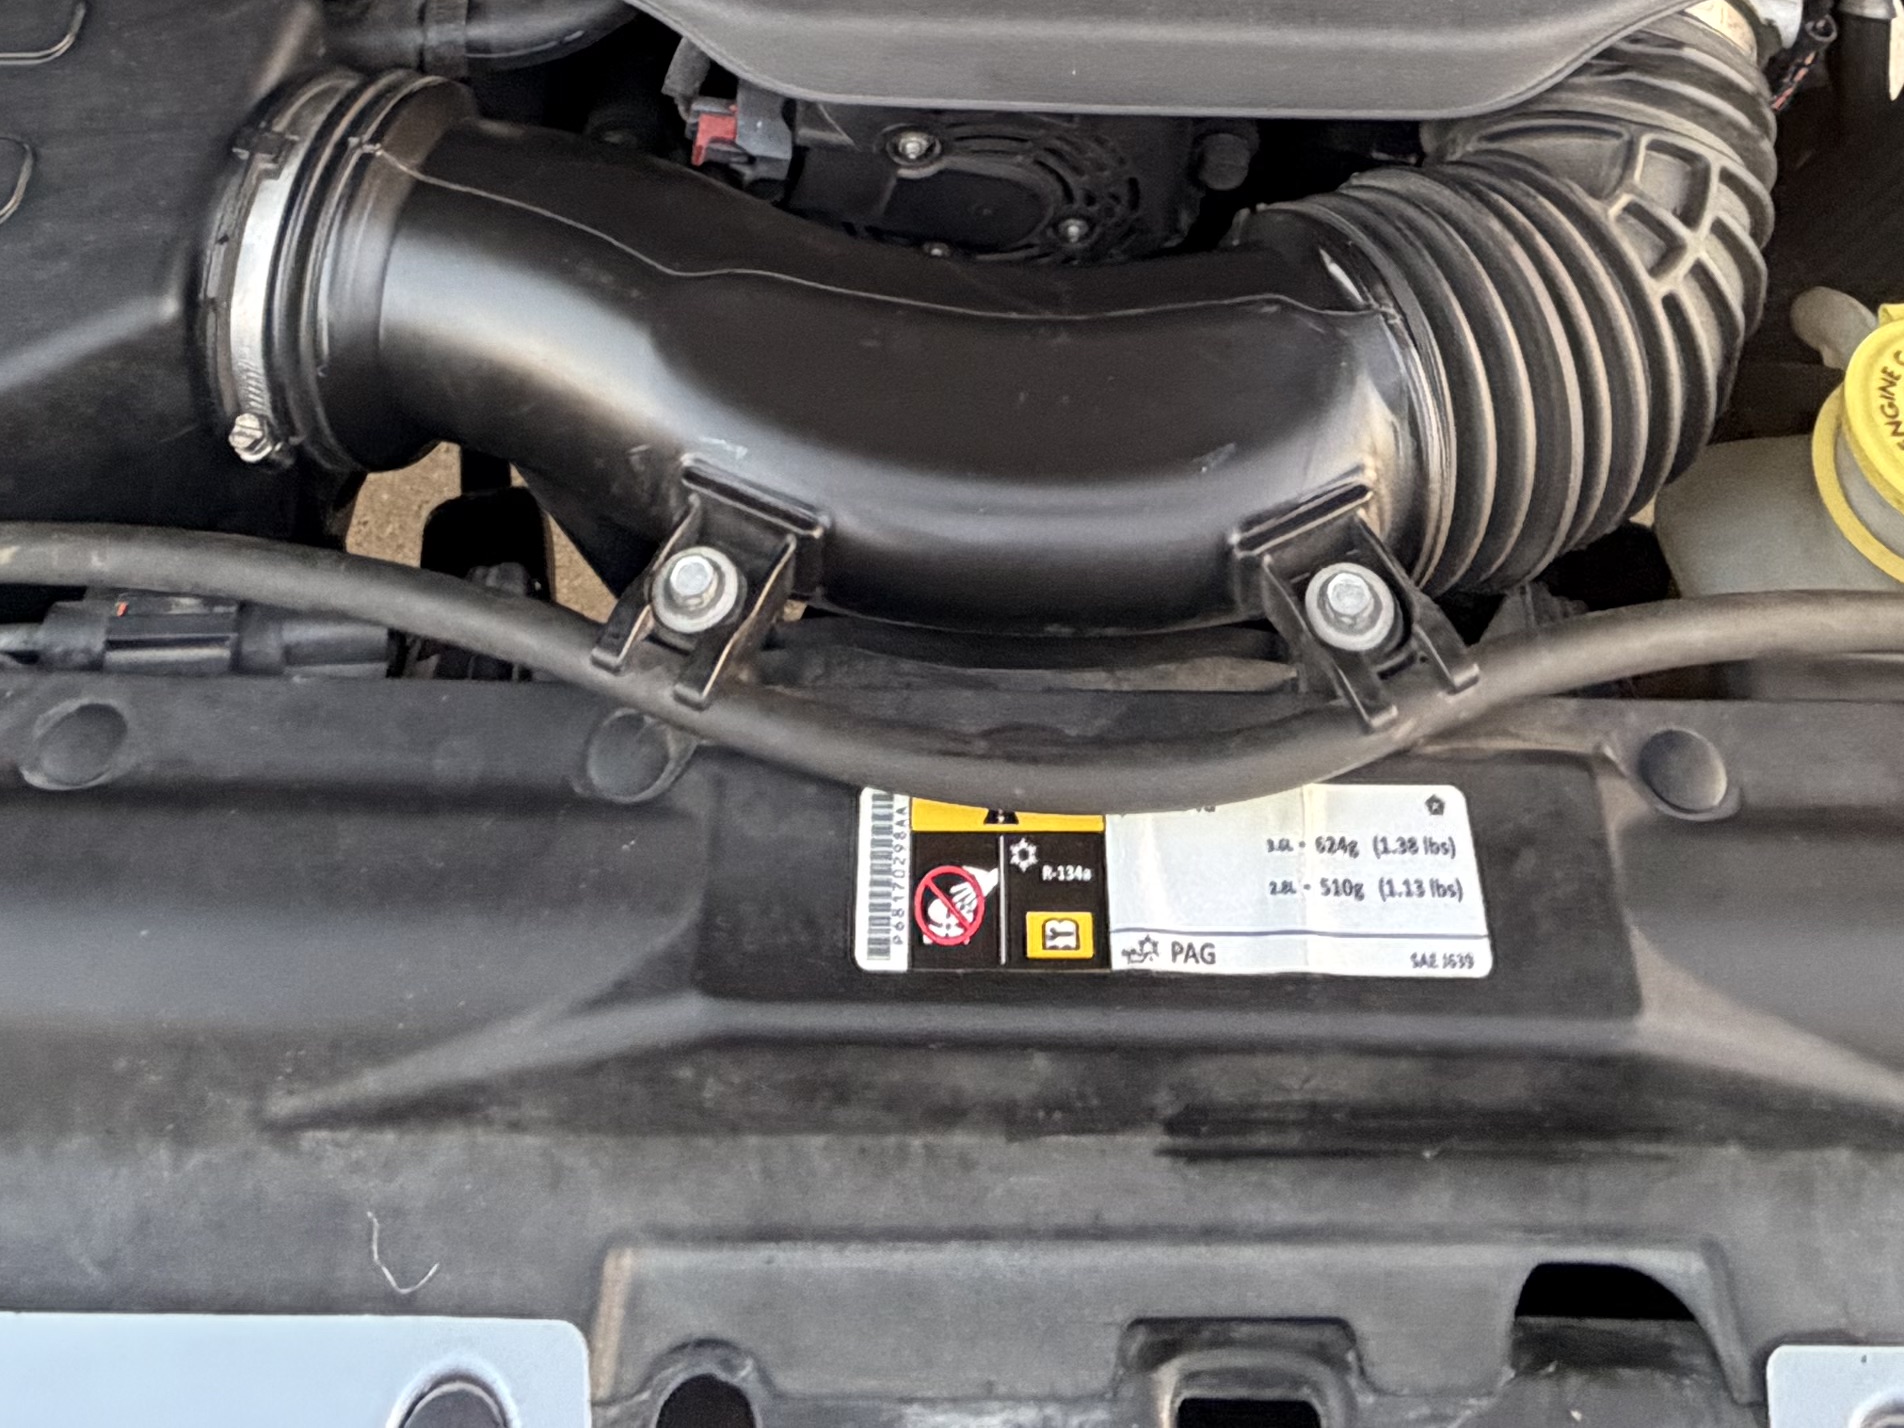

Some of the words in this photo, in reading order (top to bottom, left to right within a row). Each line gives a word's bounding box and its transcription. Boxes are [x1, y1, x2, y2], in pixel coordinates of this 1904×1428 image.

[1314, 836, 1359, 858] 624g
[1372, 835, 1419, 858] (1.38
[1423, 835, 1456, 859] lbs)
[892, 804, 908, 946] P68170298AA
[1042, 864, 1092, 882] R-134a
[1319, 877, 1365, 901] 510g
[1378, 877, 1425, 901] (1.13
[1429, 877, 1463, 902] lbs)
[1170, 940, 1216, 965] PAG
